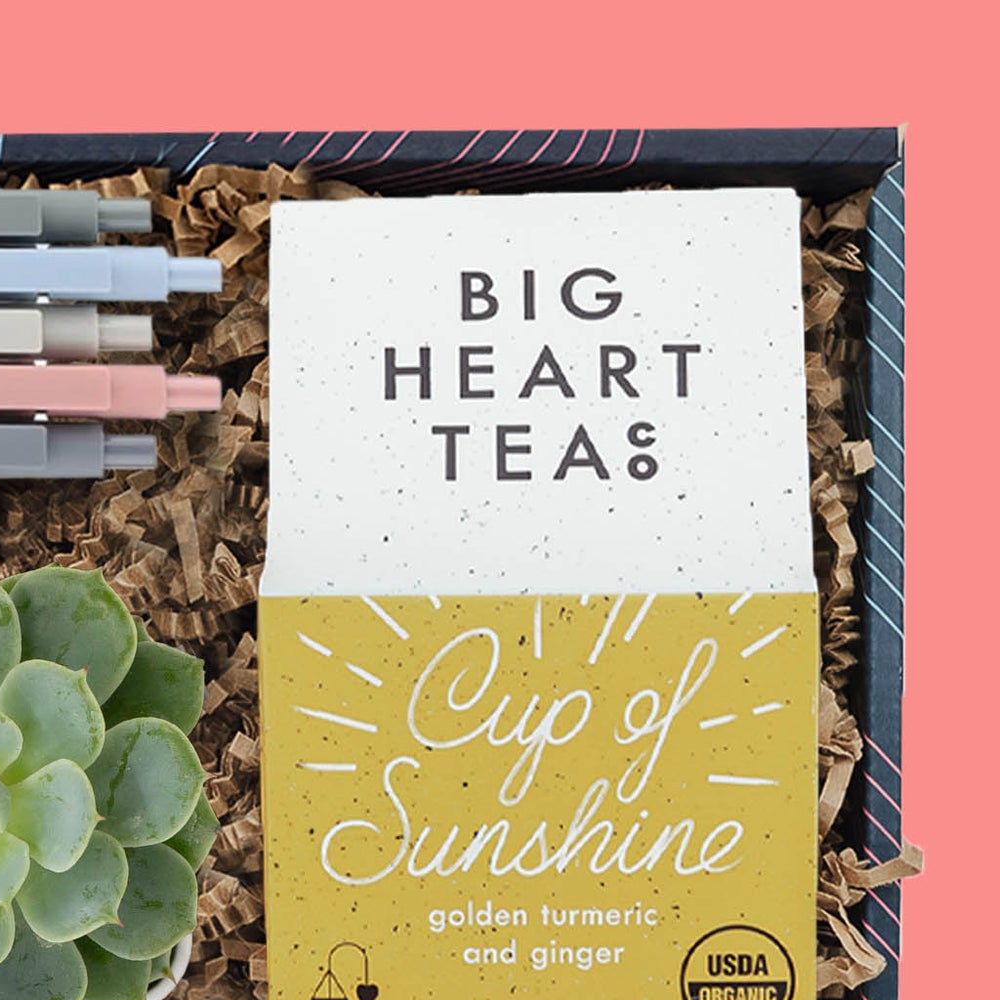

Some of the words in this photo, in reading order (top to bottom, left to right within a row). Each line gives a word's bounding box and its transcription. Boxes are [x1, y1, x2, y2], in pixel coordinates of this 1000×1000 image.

[461, 268, 623, 321] BIG
[384, 344, 701, 400] HEART
[431, 424, 611, 481] TEA
[407, 627, 592, 806] Cup
[614, 638, 719, 803] of
[320, 756, 745, 885] Sunshine
[429, 901, 528, 931] golden
[541, 901, 658, 927] turmeric
[463, 941, 517, 965] and
[530, 942, 625, 970] ginger
[707, 953, 769, 978] USDA
